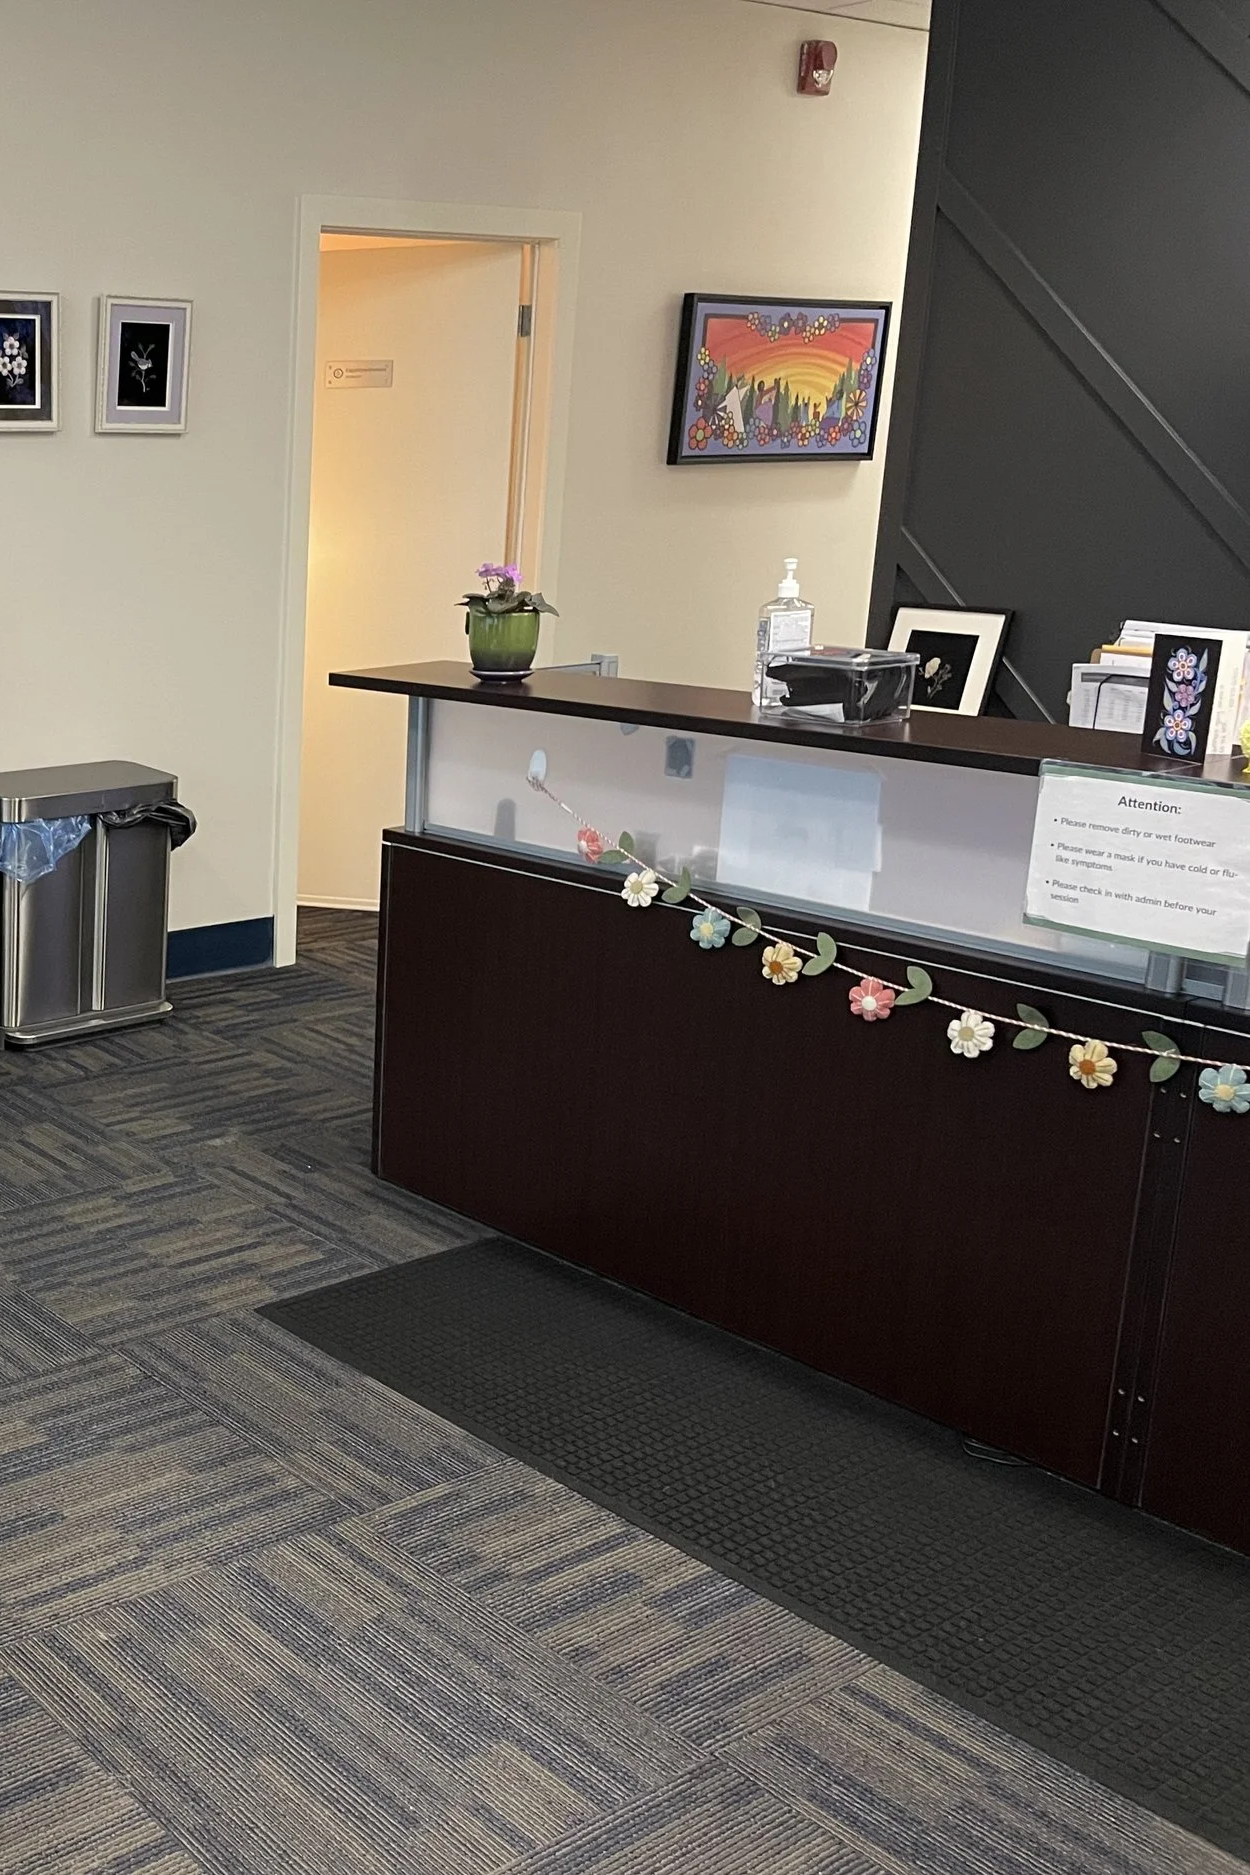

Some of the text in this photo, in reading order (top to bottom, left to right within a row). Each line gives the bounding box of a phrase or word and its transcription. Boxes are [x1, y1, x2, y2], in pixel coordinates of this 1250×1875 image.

[1118, 796, 1182, 814] Attention:
[1061, 817, 1086, 828] Please
[1089, 823, 1120, 833] remove
[1121, 827, 1142, 838] dirty
[1155, 833, 1172, 841] wet
[1174, 834, 1216, 847] footwear
[1055, 855, 1070, 864] like
[1057, 842, 1083, 853] Please
[1085, 848, 1105, 857] wear
[1114, 853, 1136, 862] mask
[1138, 855, 1145, 863] if
[1146, 858, 1163, 866] you
[1164, 860, 1186, 870] have
[1188, 865, 1208, 874] cold
[1209, 868, 1220, 876] or
[1051, 893, 1079, 903] session
[1052, 879, 1217, 916] Please check in with admin before your
